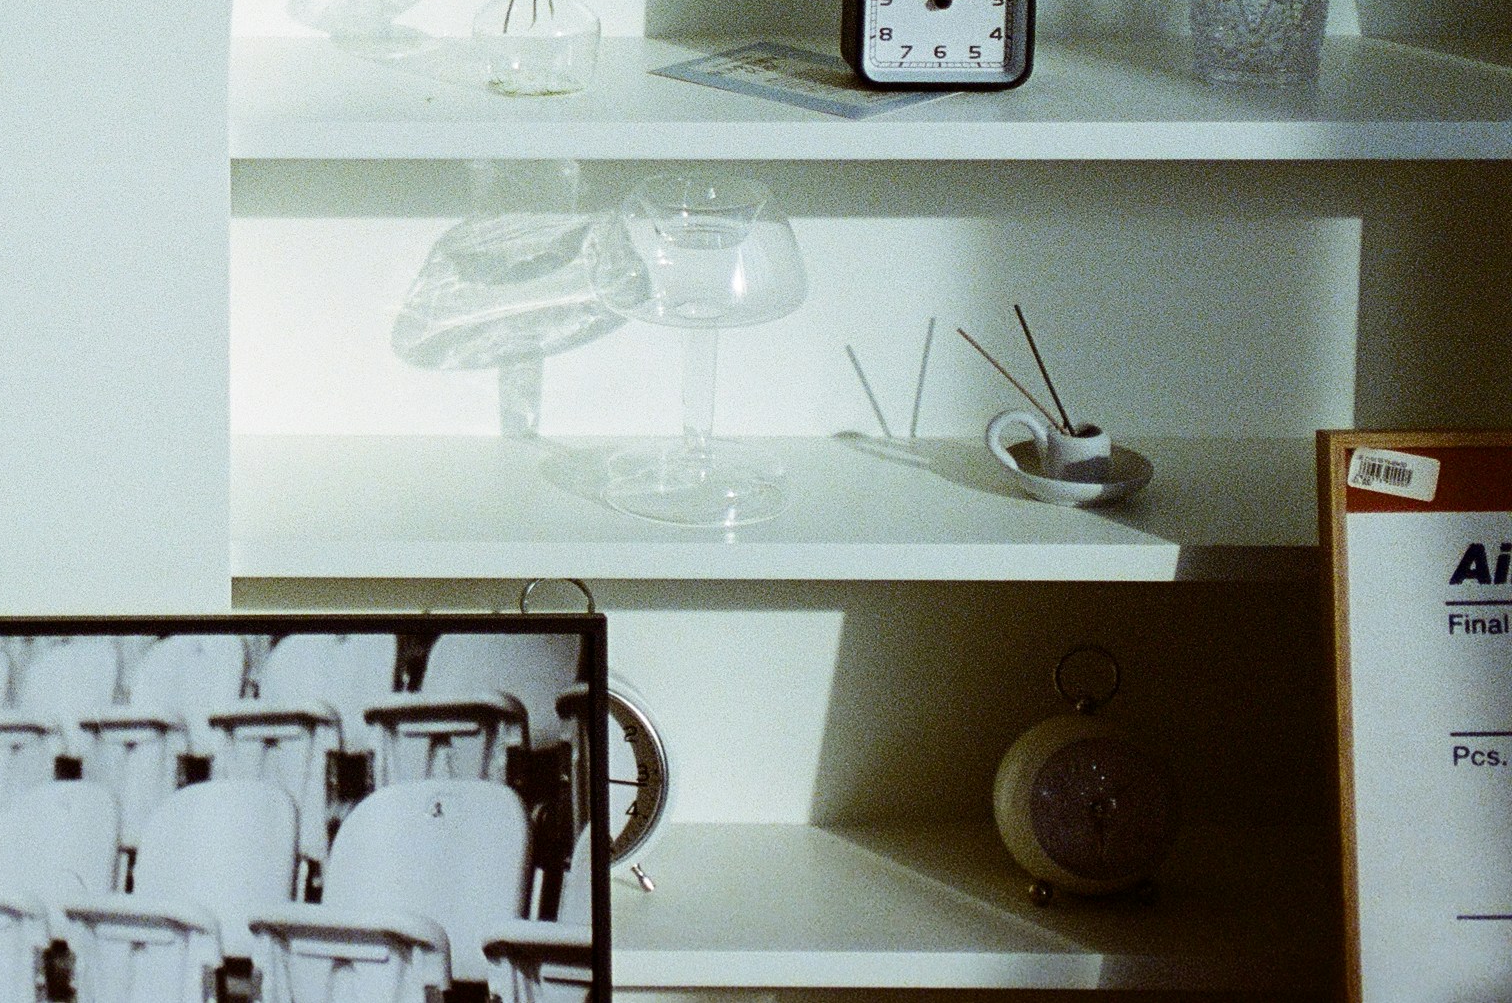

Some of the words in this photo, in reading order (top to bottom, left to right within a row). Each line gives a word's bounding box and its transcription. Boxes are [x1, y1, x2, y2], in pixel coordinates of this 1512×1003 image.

[879, 27, 893, 41] 8
[989, 27, 1003, 41] 4
[900, 45, 913, 59] 7
[933, 45, 947, 59] 6
[968, 45, 982, 59] 5
[1449, 543, 1512, 586] Ai
[1448, 614, 1509, 635] Final
[623, 725, 638, 743] 2
[1453, 745, 1508, 767] Pcs.
[636, 763, 651, 783] 3
[625, 799, 638, 817] 4
